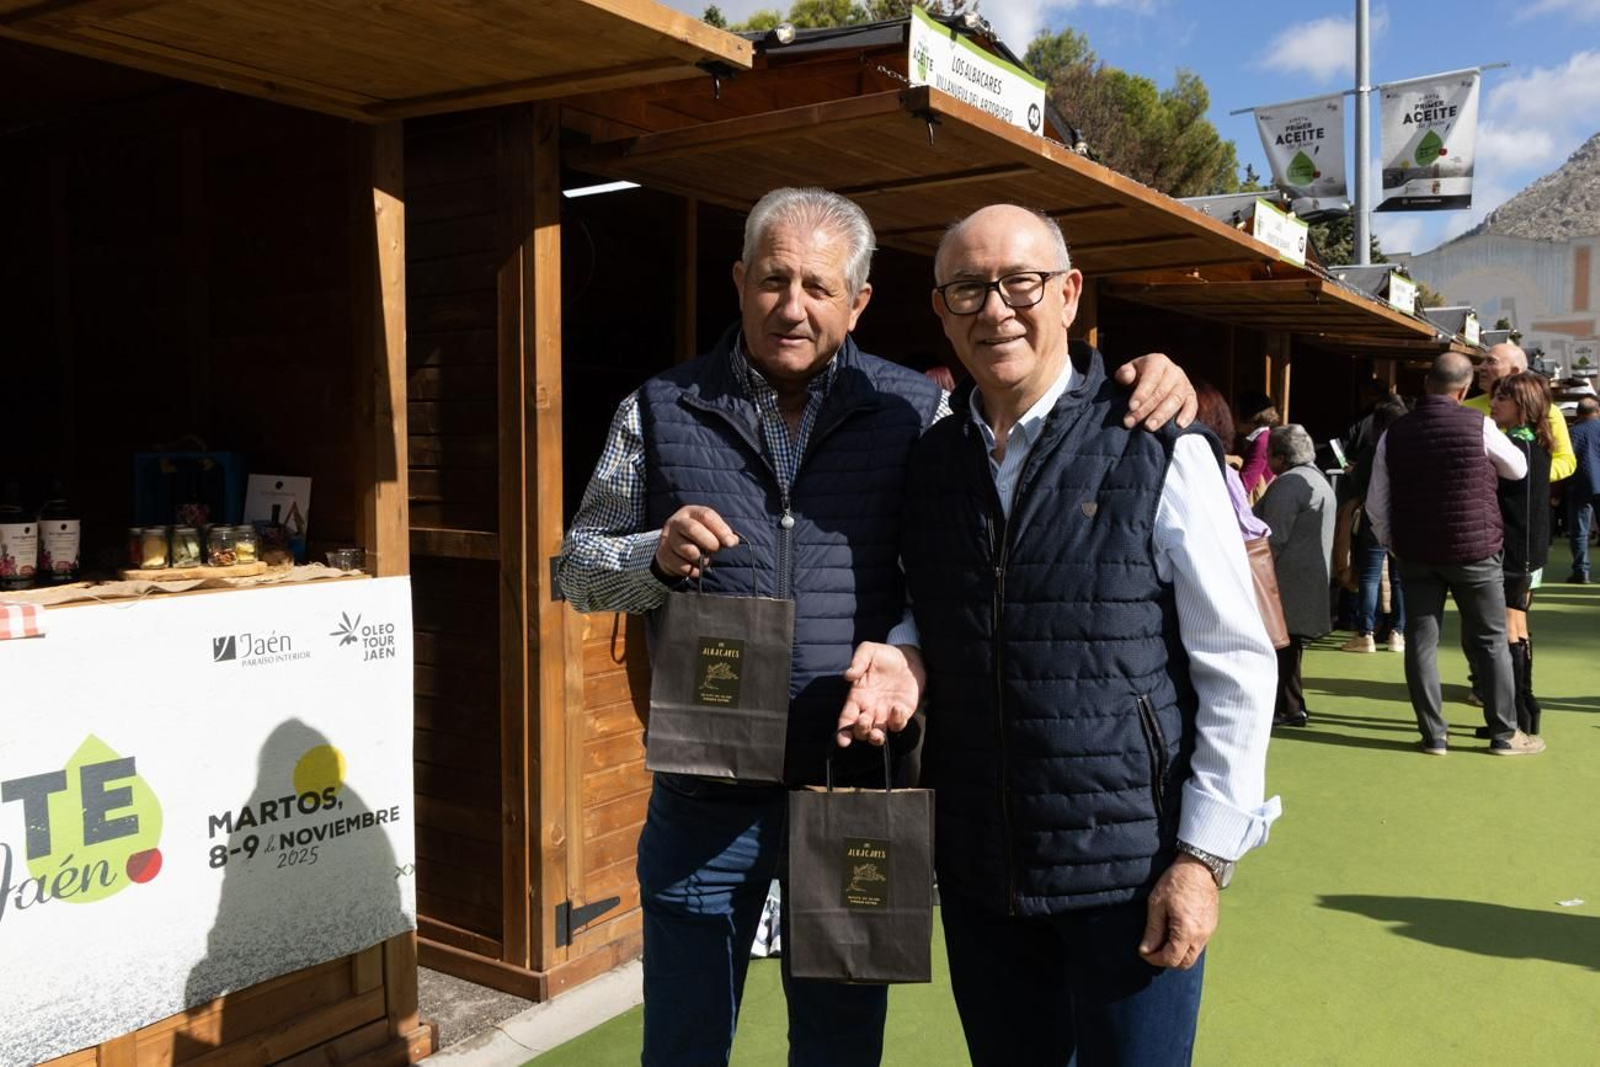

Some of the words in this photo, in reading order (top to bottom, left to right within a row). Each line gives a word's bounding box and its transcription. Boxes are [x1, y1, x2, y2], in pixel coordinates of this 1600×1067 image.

[951, 55, 965, 76] LOS
[964, 63, 1003, 96] ALBACARES
[1403, 105, 1458, 125] ACEITE
[1414, 100, 1445, 110] PRIMER
[1275, 127, 1325, 146] ACEITE
[1285, 122, 1313, 132] PRIMER
[361, 622, 396, 637] OLEO
[239, 629, 292, 659] Jaén
[362, 635, 395, 649] TOUR
[275, 651, 311, 664] INTERIOR
[0, 756, 140, 861] TE
[208, 786, 343, 839] MARTOS,
[208, 834, 260, 870] 8-9
[279, 805, 401, 851] NOVIEMBRE
[276, 845, 320, 869] 2025
